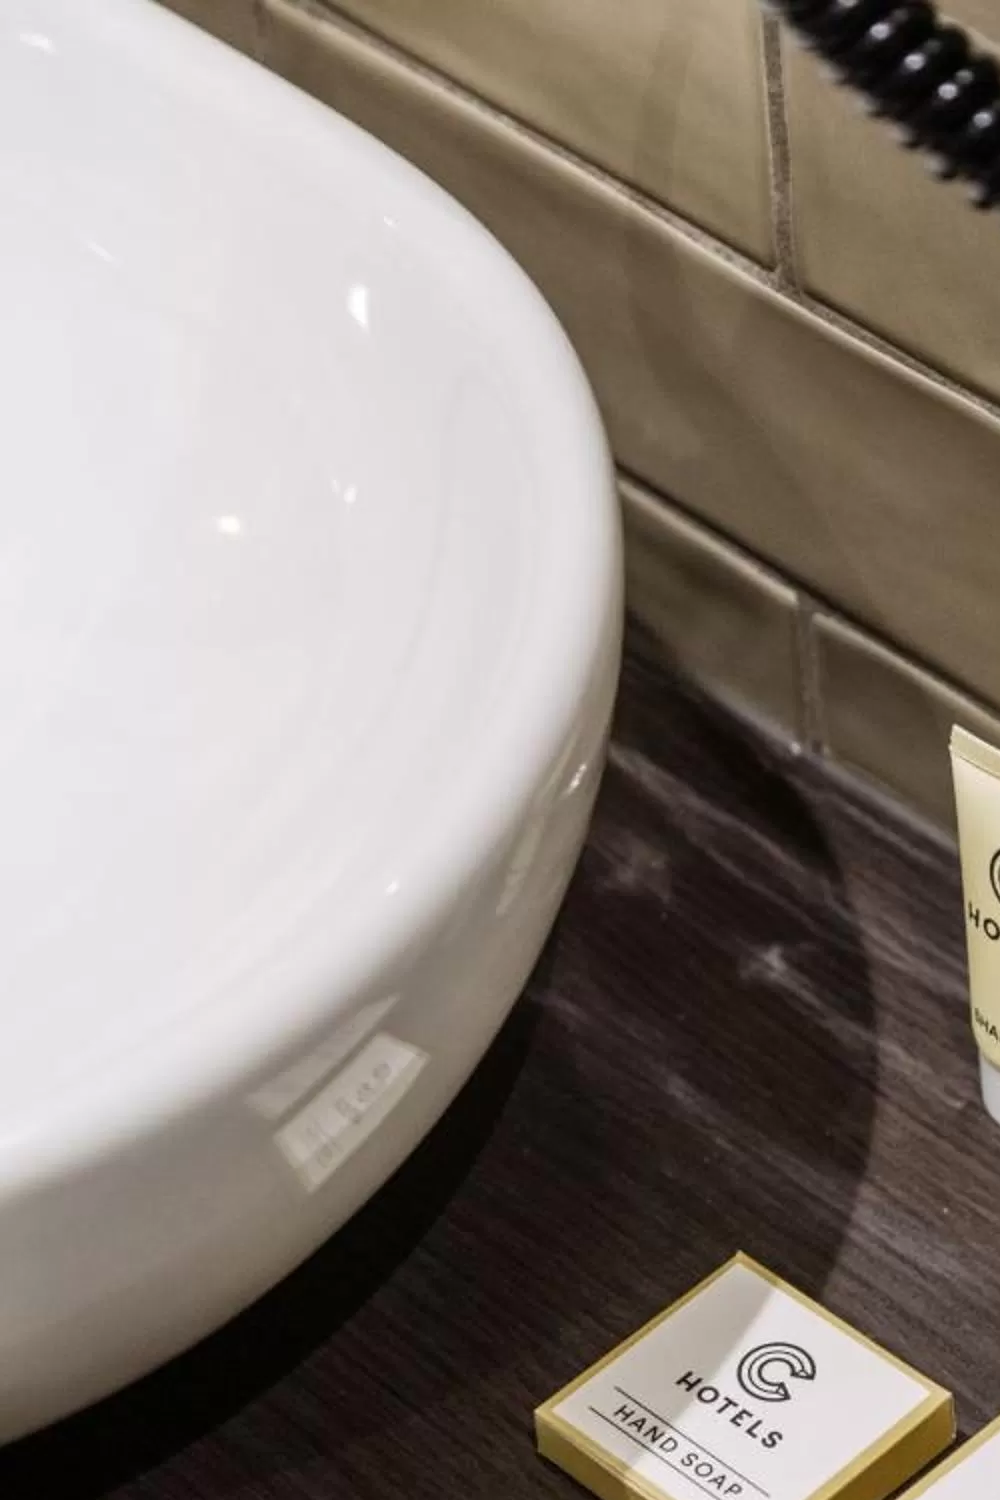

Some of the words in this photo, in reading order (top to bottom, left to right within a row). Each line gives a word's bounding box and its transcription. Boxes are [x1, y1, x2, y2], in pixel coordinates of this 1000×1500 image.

[613, 1404, 679, 1453] HAND
[680, 1452, 743, 1496] SOAP
[676, 1371, 784, 1449] HOTELS
